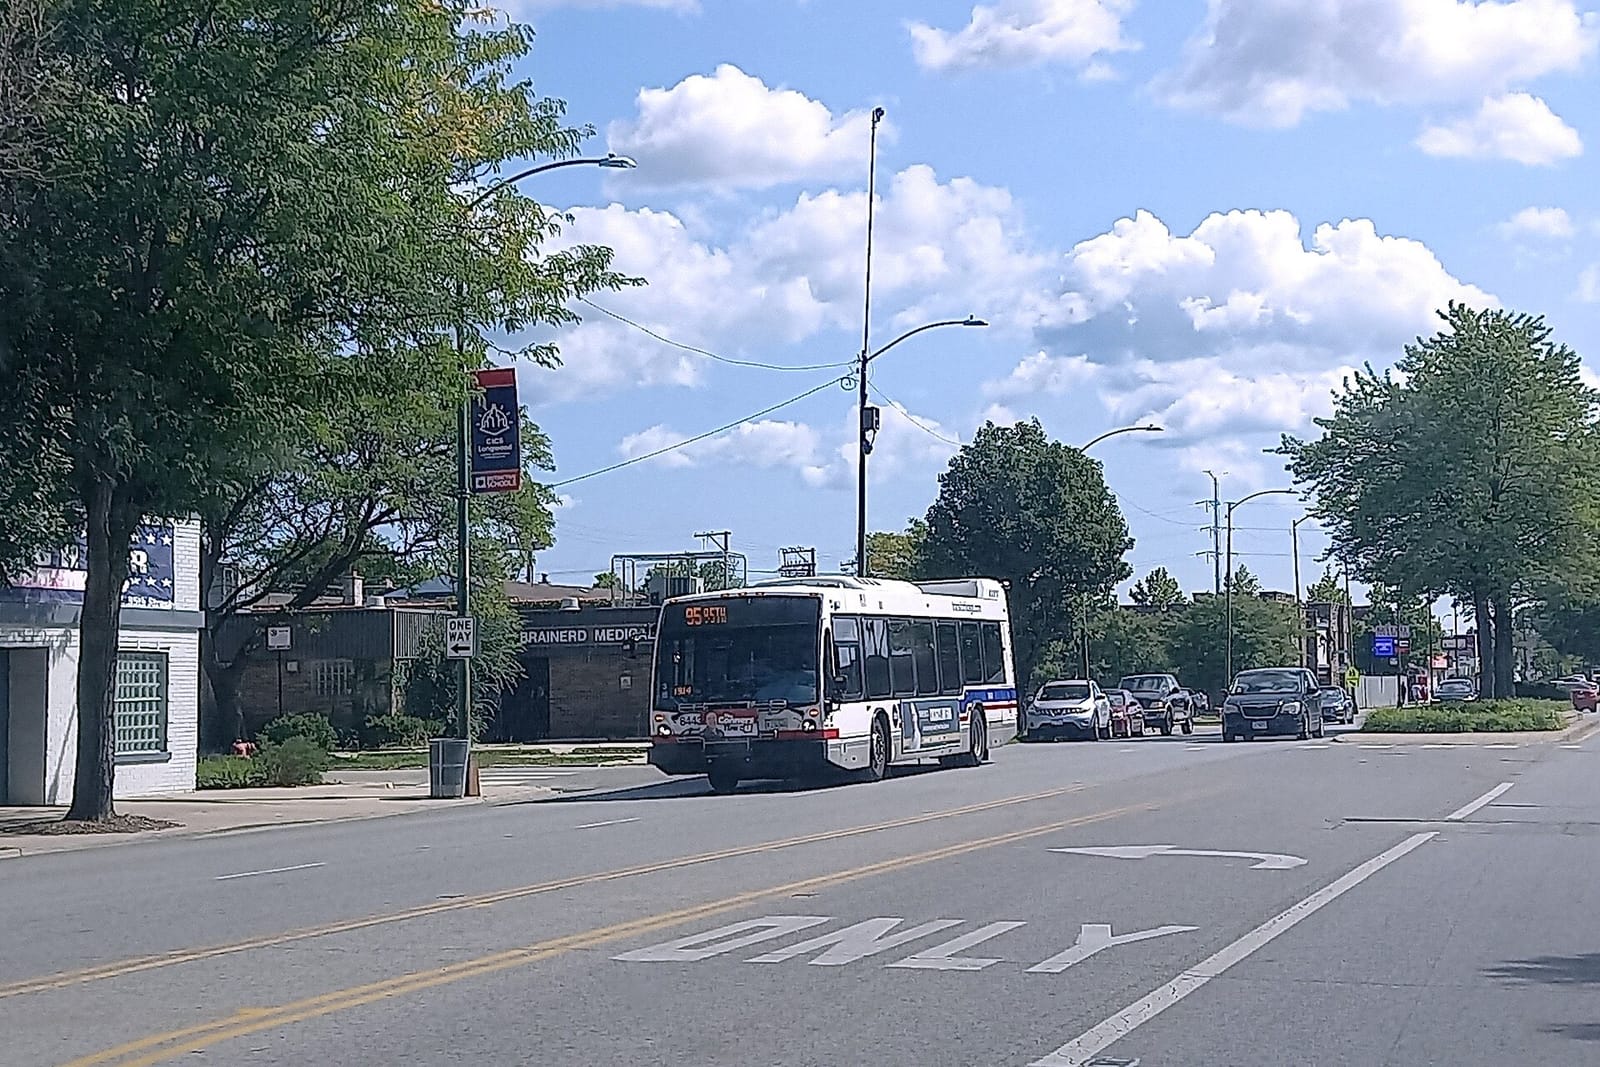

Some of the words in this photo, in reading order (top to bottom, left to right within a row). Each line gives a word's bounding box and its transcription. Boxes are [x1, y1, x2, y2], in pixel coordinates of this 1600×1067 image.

[686, 607, 702, 625] 95
[449, 620, 472, 631] ONE
[448, 631, 472, 642] WAY
[520, 629, 587, 643] BRAINERD
[610, 915, 1200, 974] ONLY
